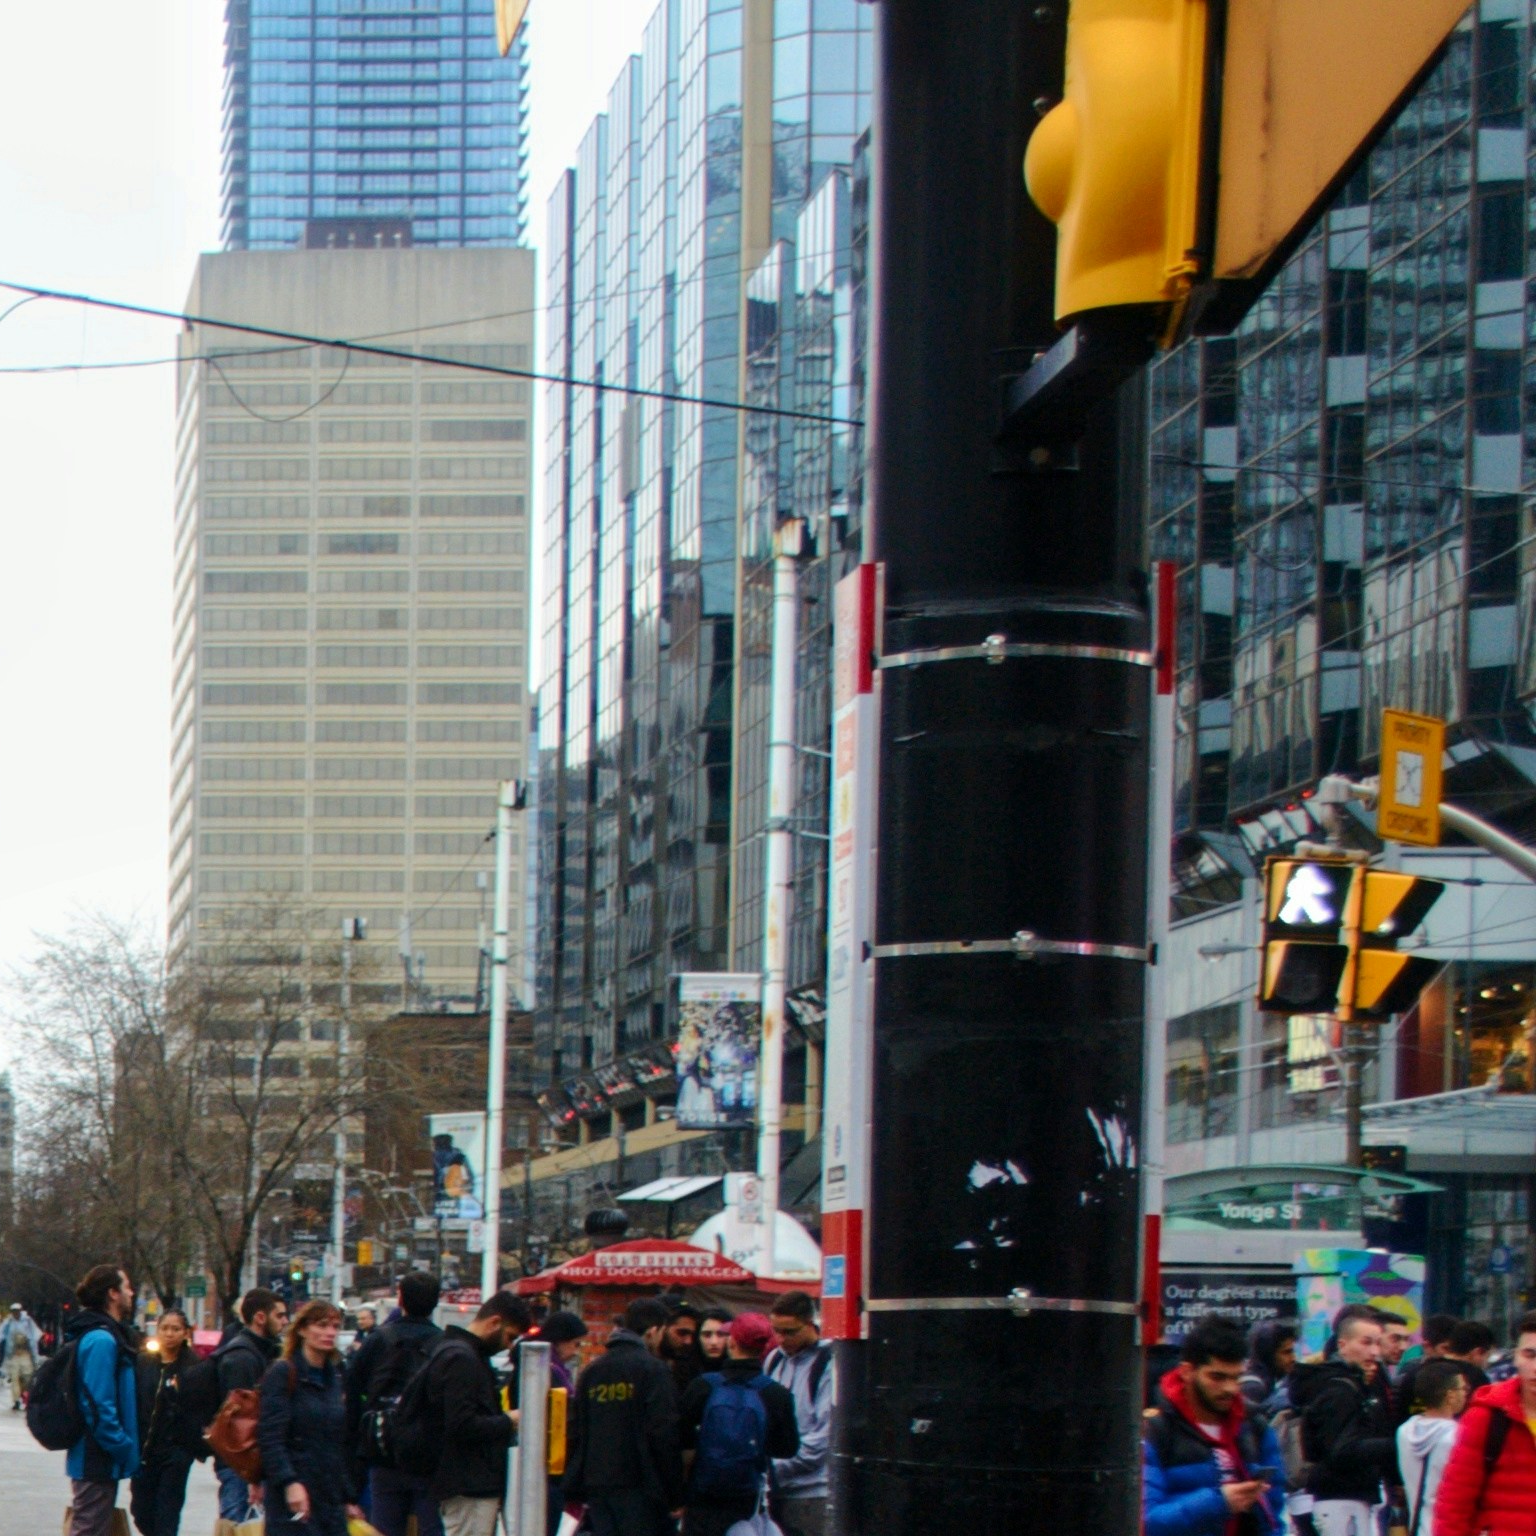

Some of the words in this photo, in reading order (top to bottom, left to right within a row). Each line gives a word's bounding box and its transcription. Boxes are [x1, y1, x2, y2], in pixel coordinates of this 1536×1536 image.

[1219, 1202, 1275, 1223] Yonge
[1280, 1203, 1302, 1220] St
[1165, 1284, 1195, 1299] Our
[1197, 1283, 1254, 1301] degrees
[1164, 1306, 1175, 1317] a
[1244, 1306, 1279, 1321] type
